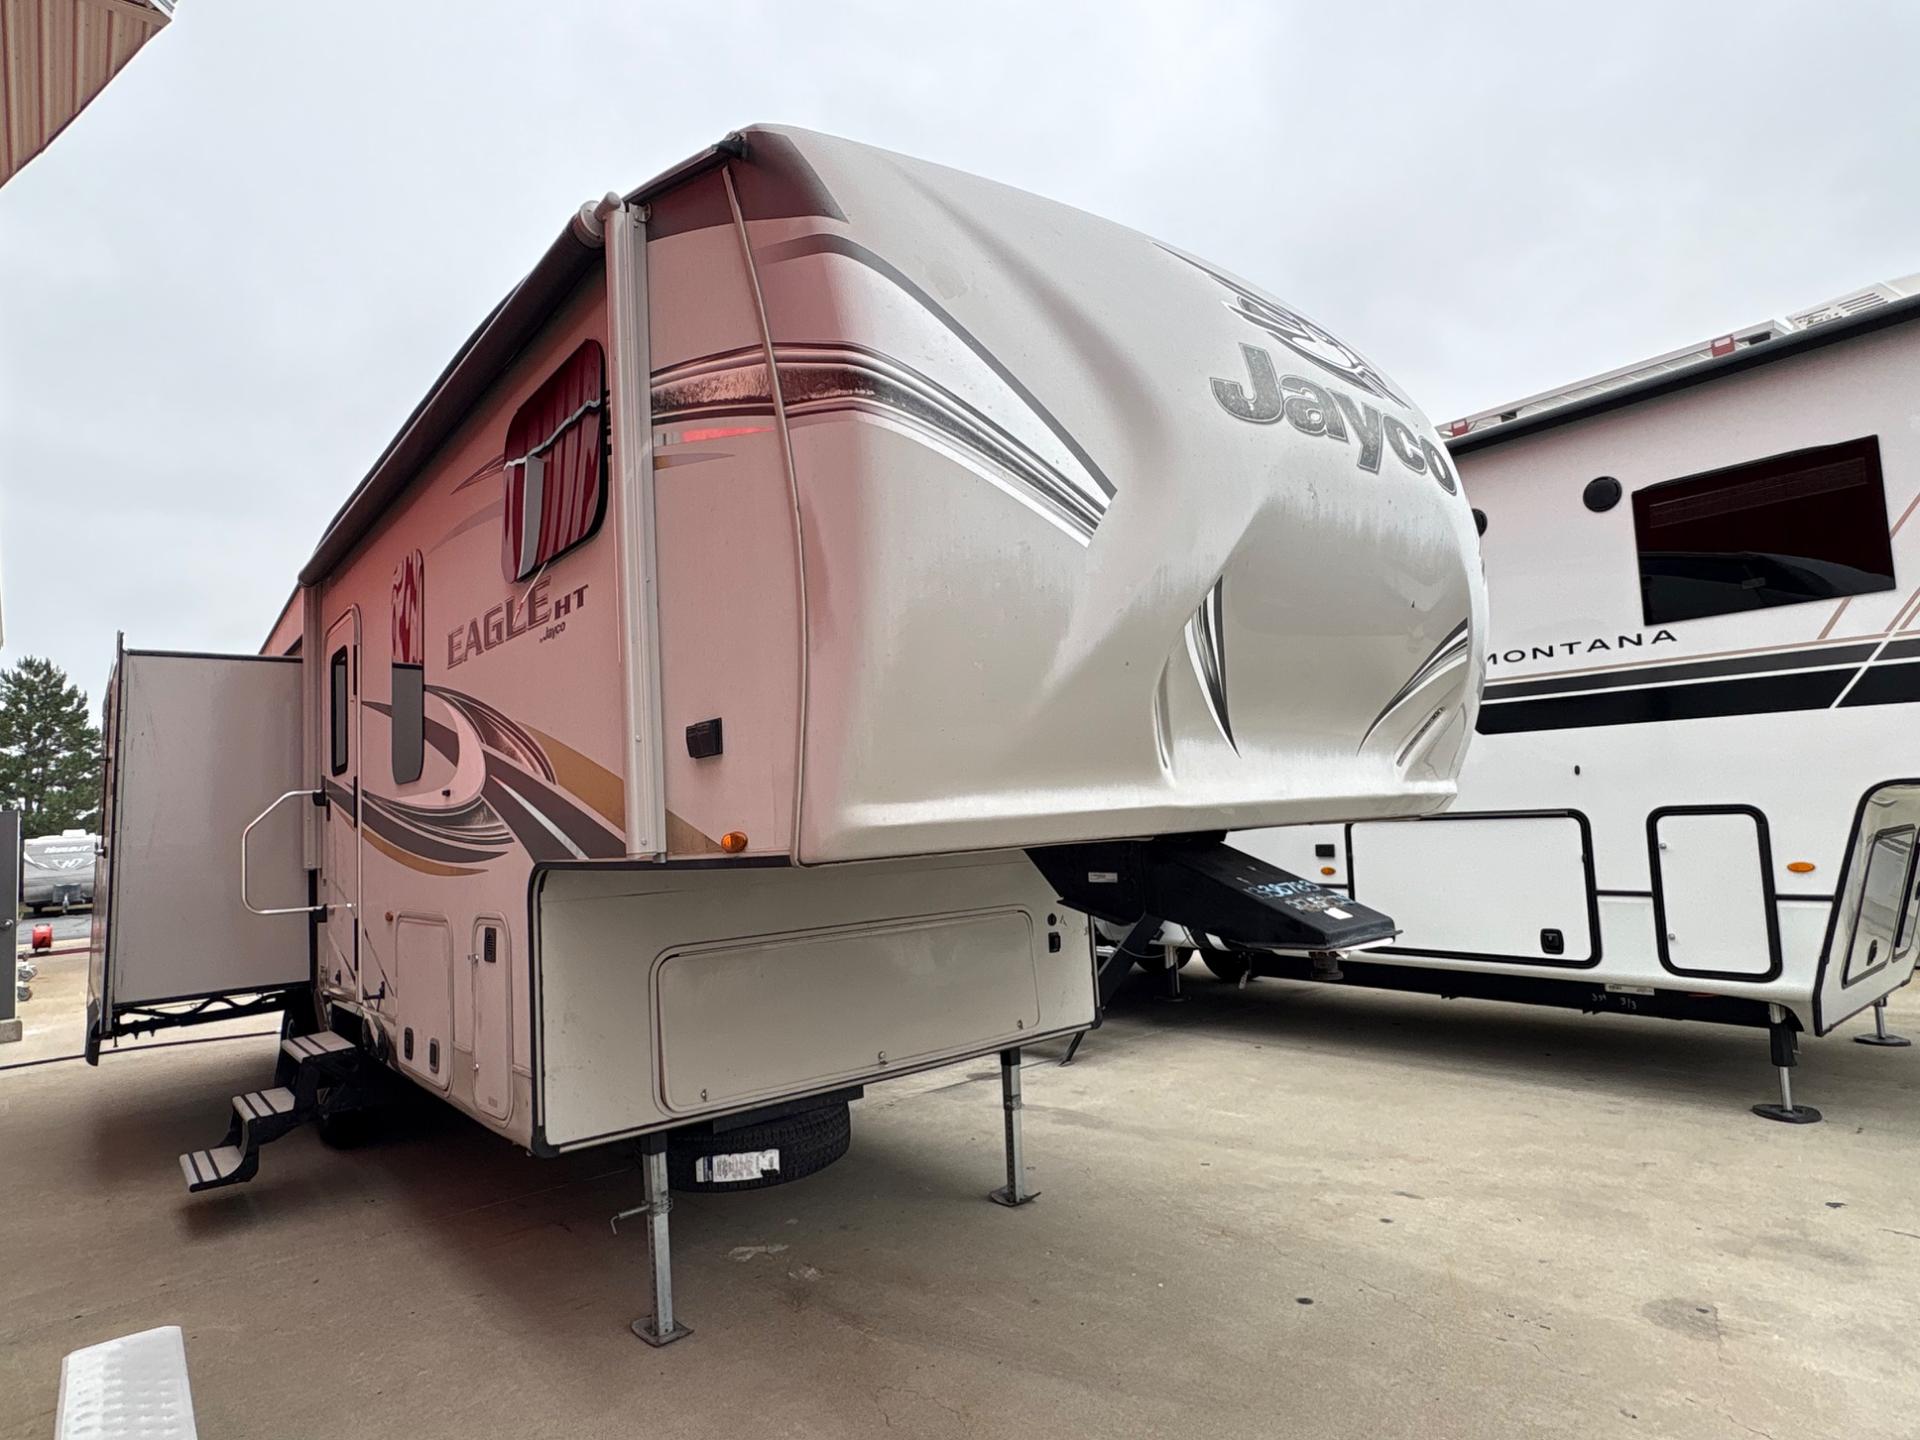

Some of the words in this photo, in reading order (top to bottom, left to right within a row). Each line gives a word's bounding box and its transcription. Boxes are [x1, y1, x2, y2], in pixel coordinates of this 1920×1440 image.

[1209, 342, 1457, 496] Jayco
[447, 575, 552, 670] EAGLE
[554, 584, 589, 620] HT
